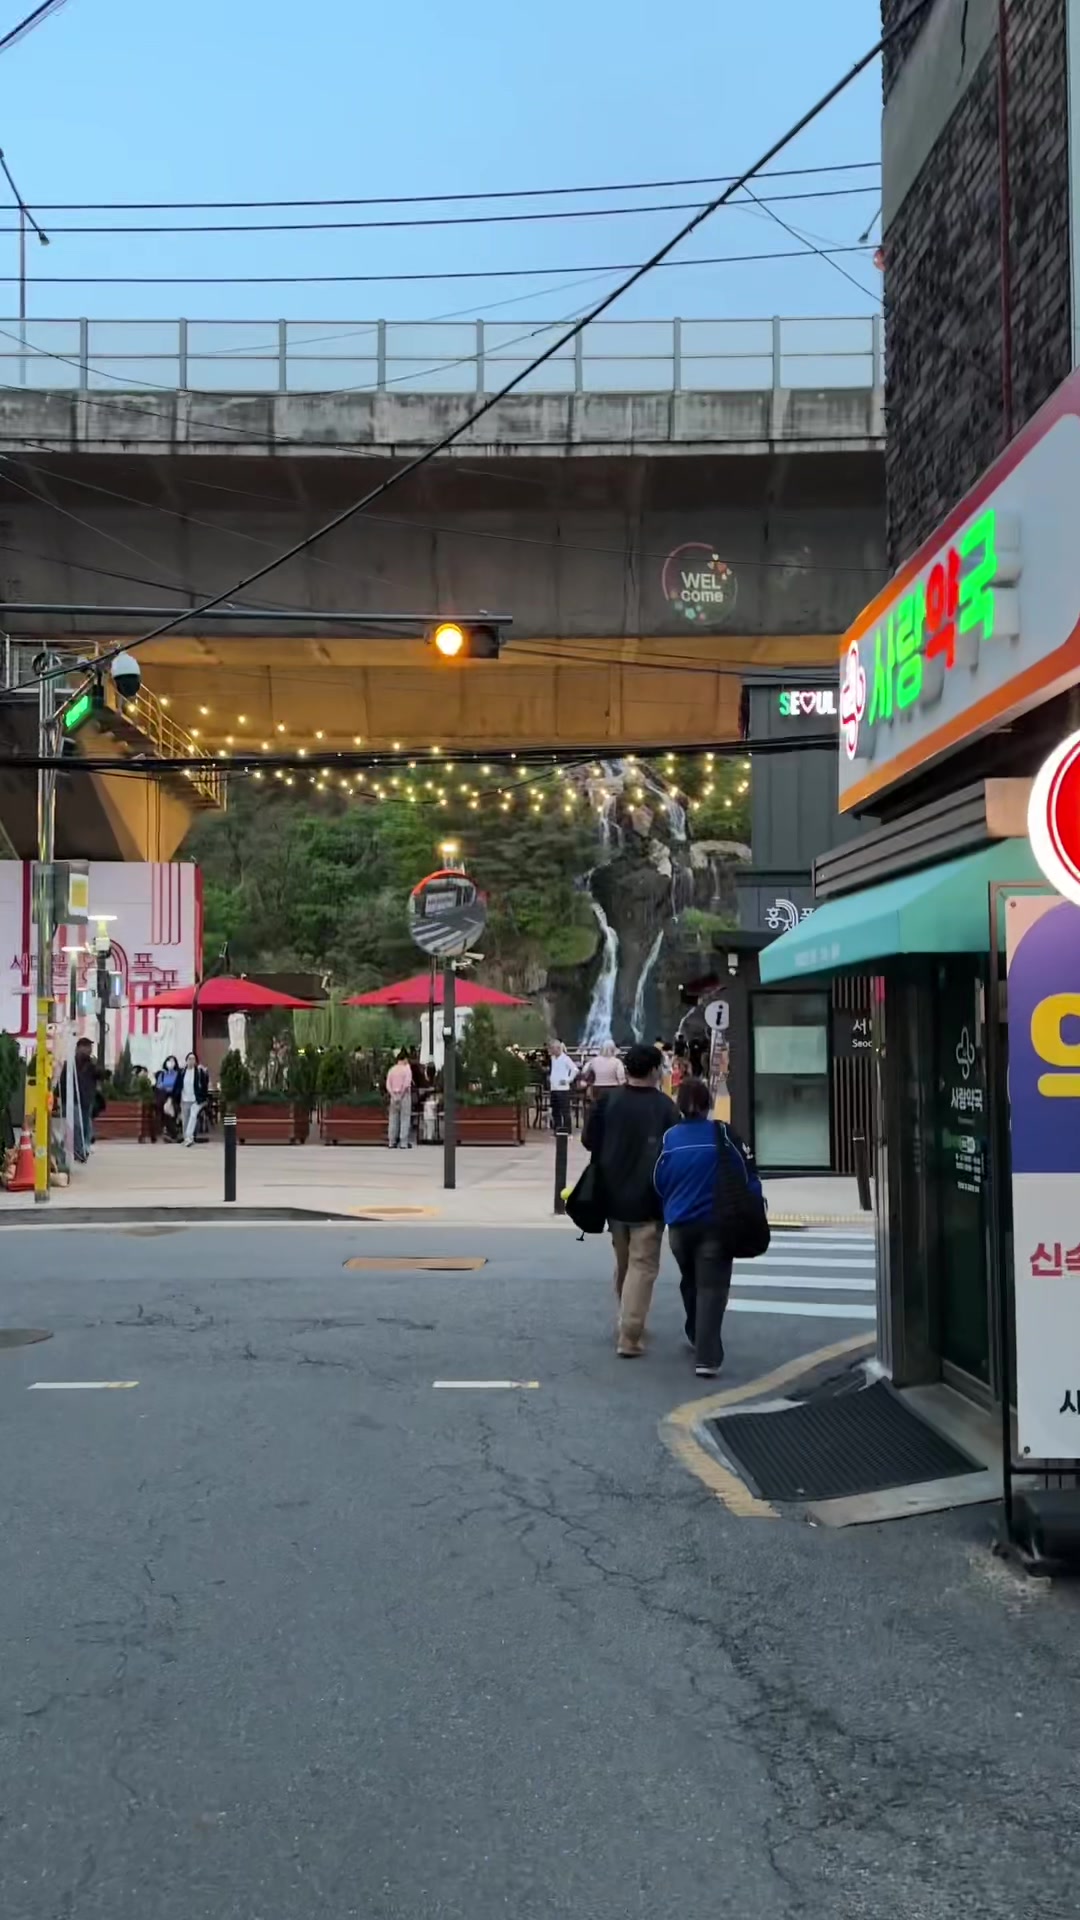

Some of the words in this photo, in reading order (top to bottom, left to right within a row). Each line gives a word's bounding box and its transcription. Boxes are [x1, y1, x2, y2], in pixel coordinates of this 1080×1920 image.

[681, 571, 722, 590] WEL
[681, 589, 724, 603] come
[868, 507, 998, 727] 사랑약국
[852, 1018, 873, 1035] 서
[951, 1087, 984, 1112] 사랑약국
